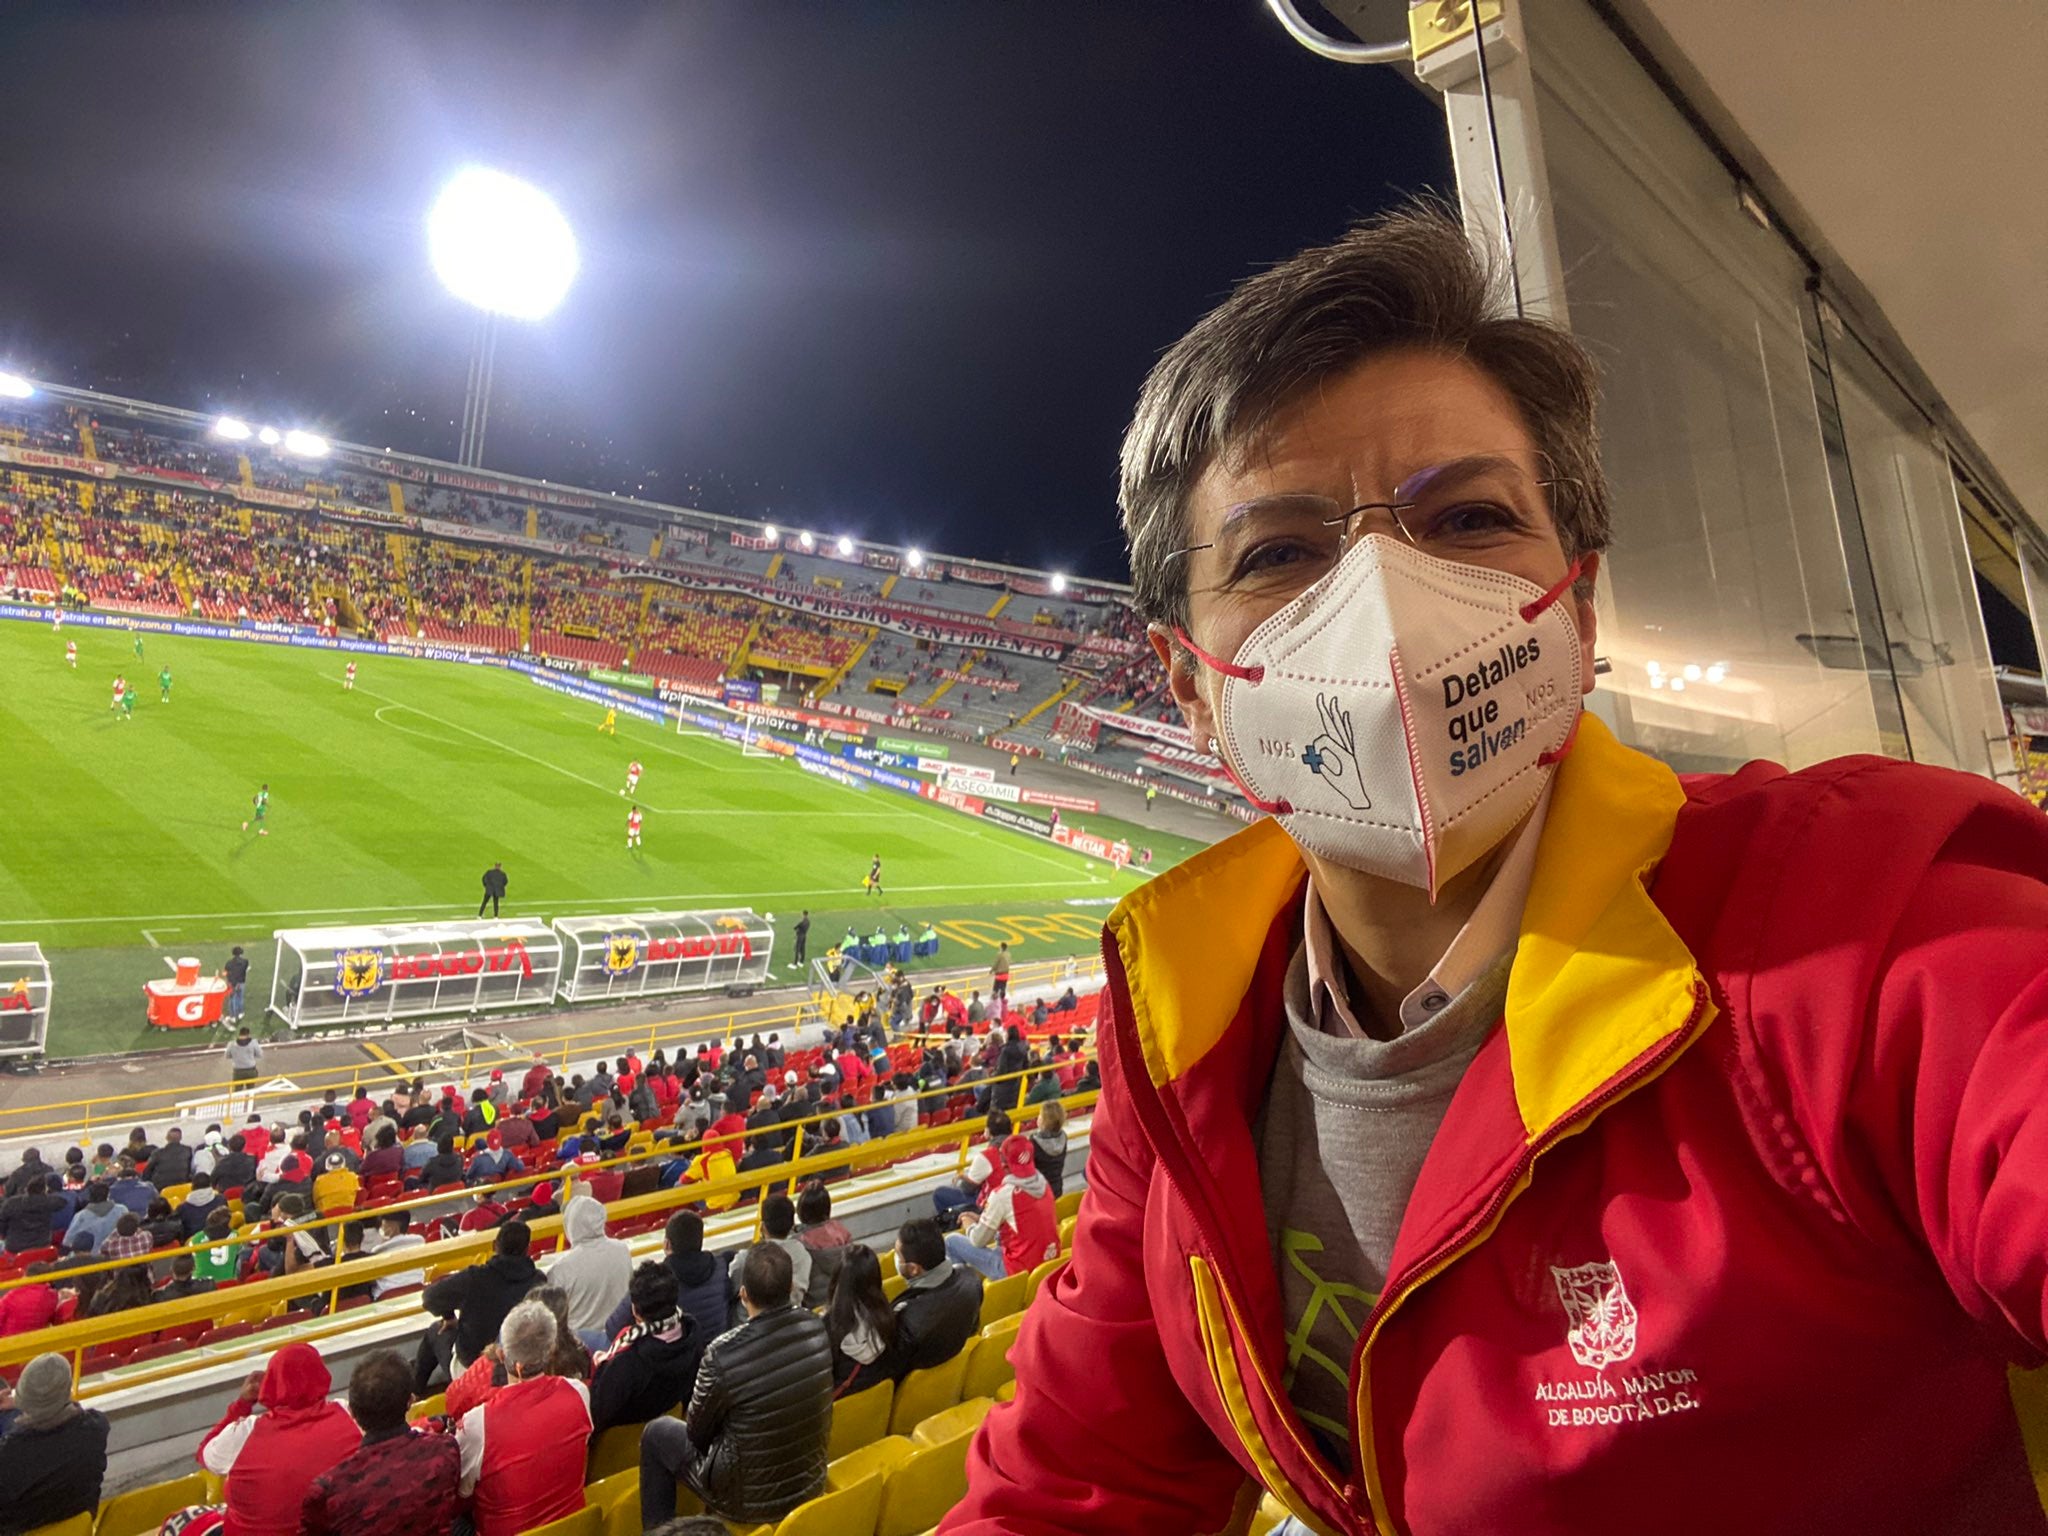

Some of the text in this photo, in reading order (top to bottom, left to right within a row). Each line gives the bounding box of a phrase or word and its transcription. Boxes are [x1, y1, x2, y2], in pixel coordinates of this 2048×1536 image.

[619, 562, 708, 587] UNIDOS
[775, 589, 805, 607] UN
[812, 600, 892, 625] MISMO
[898, 618, 1057, 660] SENTIMIENTO
[545, 658, 577, 671] BOLTY
[1442, 637, 1541, 709] Detalles
[671, 682, 719, 698] GATORADE
[1525, 677, 1555, 711] N95
[1448, 699, 1499, 744] que
[992, 738, 1034, 756] OZZY
[1259, 738, 1296, 760] N95
[1450, 716, 1526, 777] salvan
[176, 994, 205, 1021] G
[1535, 1368, 1699, 1401] ALCALDÍA MAYOR
[1548, 1391, 1700, 1426] DE BOGOTÁ D.C.
